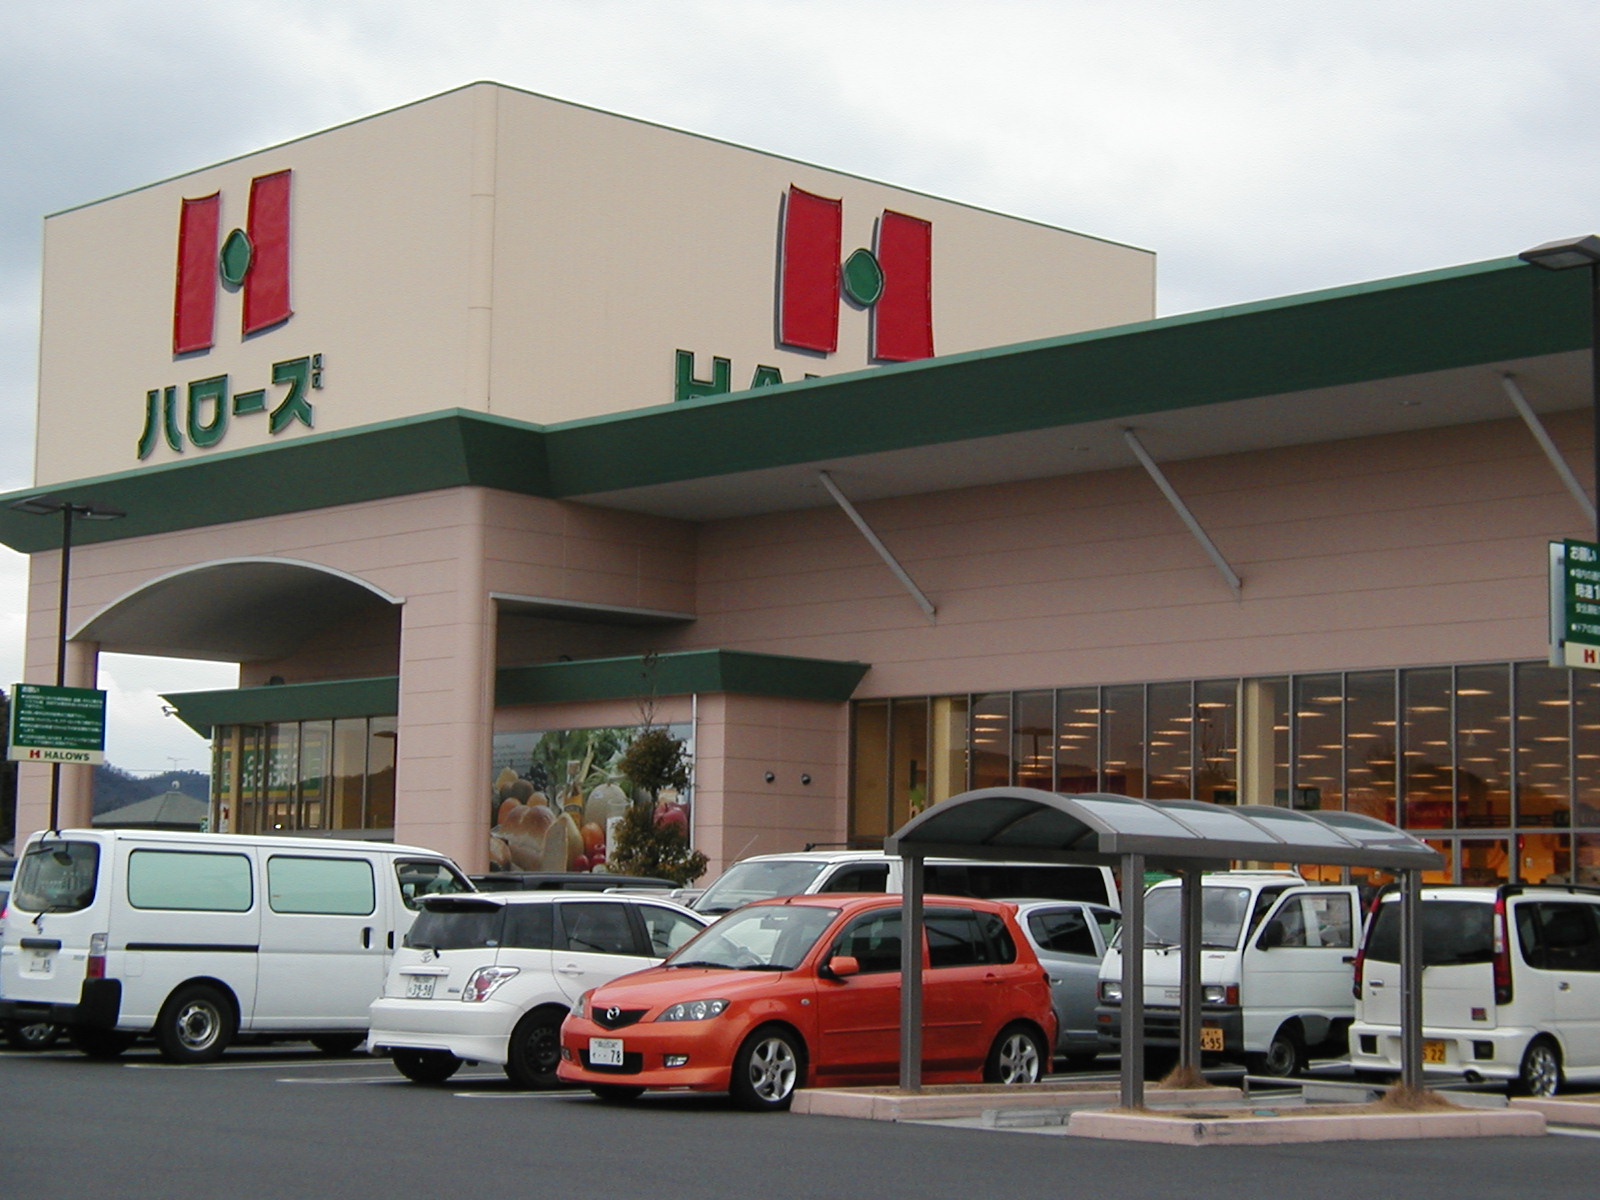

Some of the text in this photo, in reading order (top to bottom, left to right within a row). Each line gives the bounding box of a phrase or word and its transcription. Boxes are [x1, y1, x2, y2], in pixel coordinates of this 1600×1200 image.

[137, 352, 323, 460] ハローズ
[44, 750, 90, 761] HALOWS
